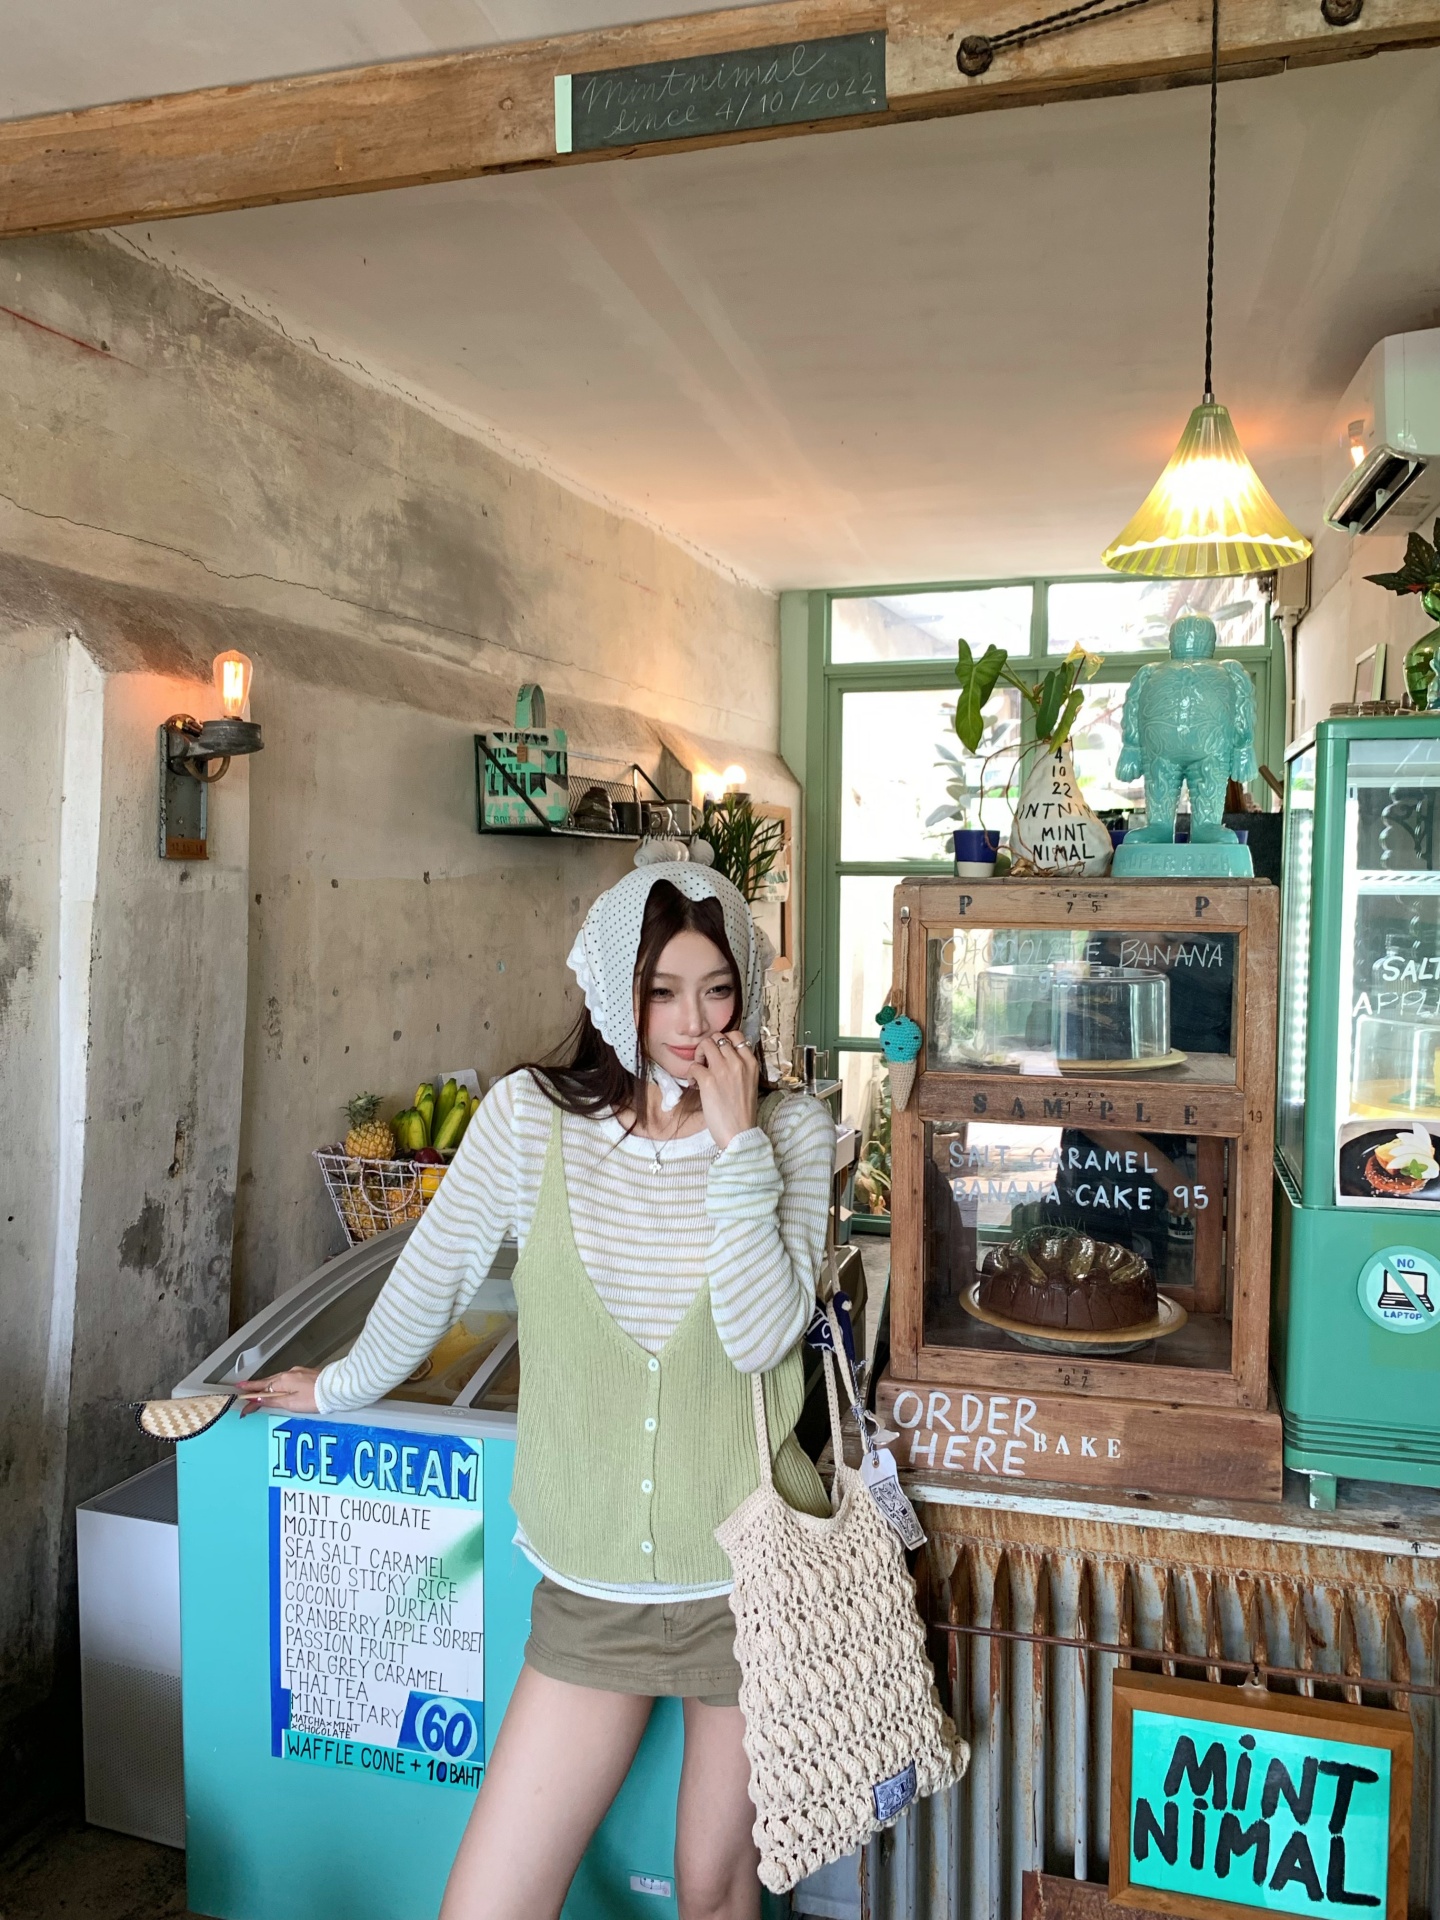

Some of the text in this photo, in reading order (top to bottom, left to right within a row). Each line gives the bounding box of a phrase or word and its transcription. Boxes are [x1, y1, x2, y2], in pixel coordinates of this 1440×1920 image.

[714, 72, 876, 126] 4/10/2022
[1052, 765, 1066, 777] 10
[1055, 746, 1063, 763] 4
[1052, 782, 1073, 798] 22
[1041, 823, 1087, 841] MINT
[1033, 844, 1095, 861] NIMAL
[958, 895, 973, 914] P
[1195, 896, 1210, 917] P
[940, 935, 1223, 968] CHOCOLATE BANANA
[973, 1093, 1198, 1126] SAMPLE
[1248, 1110, 1263, 1123] 19
[949, 1141, 1158, 1174] SALT CARAMEL
[953, 1177, 1210, 1211] BANANA CAKE 95
[1396, 1258, 1415, 1269] NO
[1384, 1310, 1422, 1321] LAPTOP
[893, 1390, 1038, 1438] ORDER
[908, 1430, 1026, 1476] HERE
[1033, 1432, 1122, 1459] BAKE
[272, 1429, 479, 1501] ICE CREAM
[284, 1491, 431, 1530] MINT CHOCOLATE
[284, 1515, 351, 1541] MOJITO
[285, 1537, 450, 1579] SEA SALT CARAMEL
[285, 1559, 458, 1603] MANGO STICKY RICE
[285, 1581, 452, 1626] COCONUT DURIAN
[285, 1603, 484, 1653] CRANBERRY APPLE SORBET
[286, 1626, 408, 1664] PASSION FRUIT
[285, 1669, 369, 1702] THAI TEA
[374, 1663, 448, 1693] CARAMEL
[291, 1693, 403, 1729] MINTLITARY
[422, 1704, 472, 1758] 60
[287, 1734, 353, 1766] WAFFLE
[361, 1747, 406, 1774] CONE
[427, 1759, 447, 1783] 10
[450, 1764, 484, 1789] BAHT
